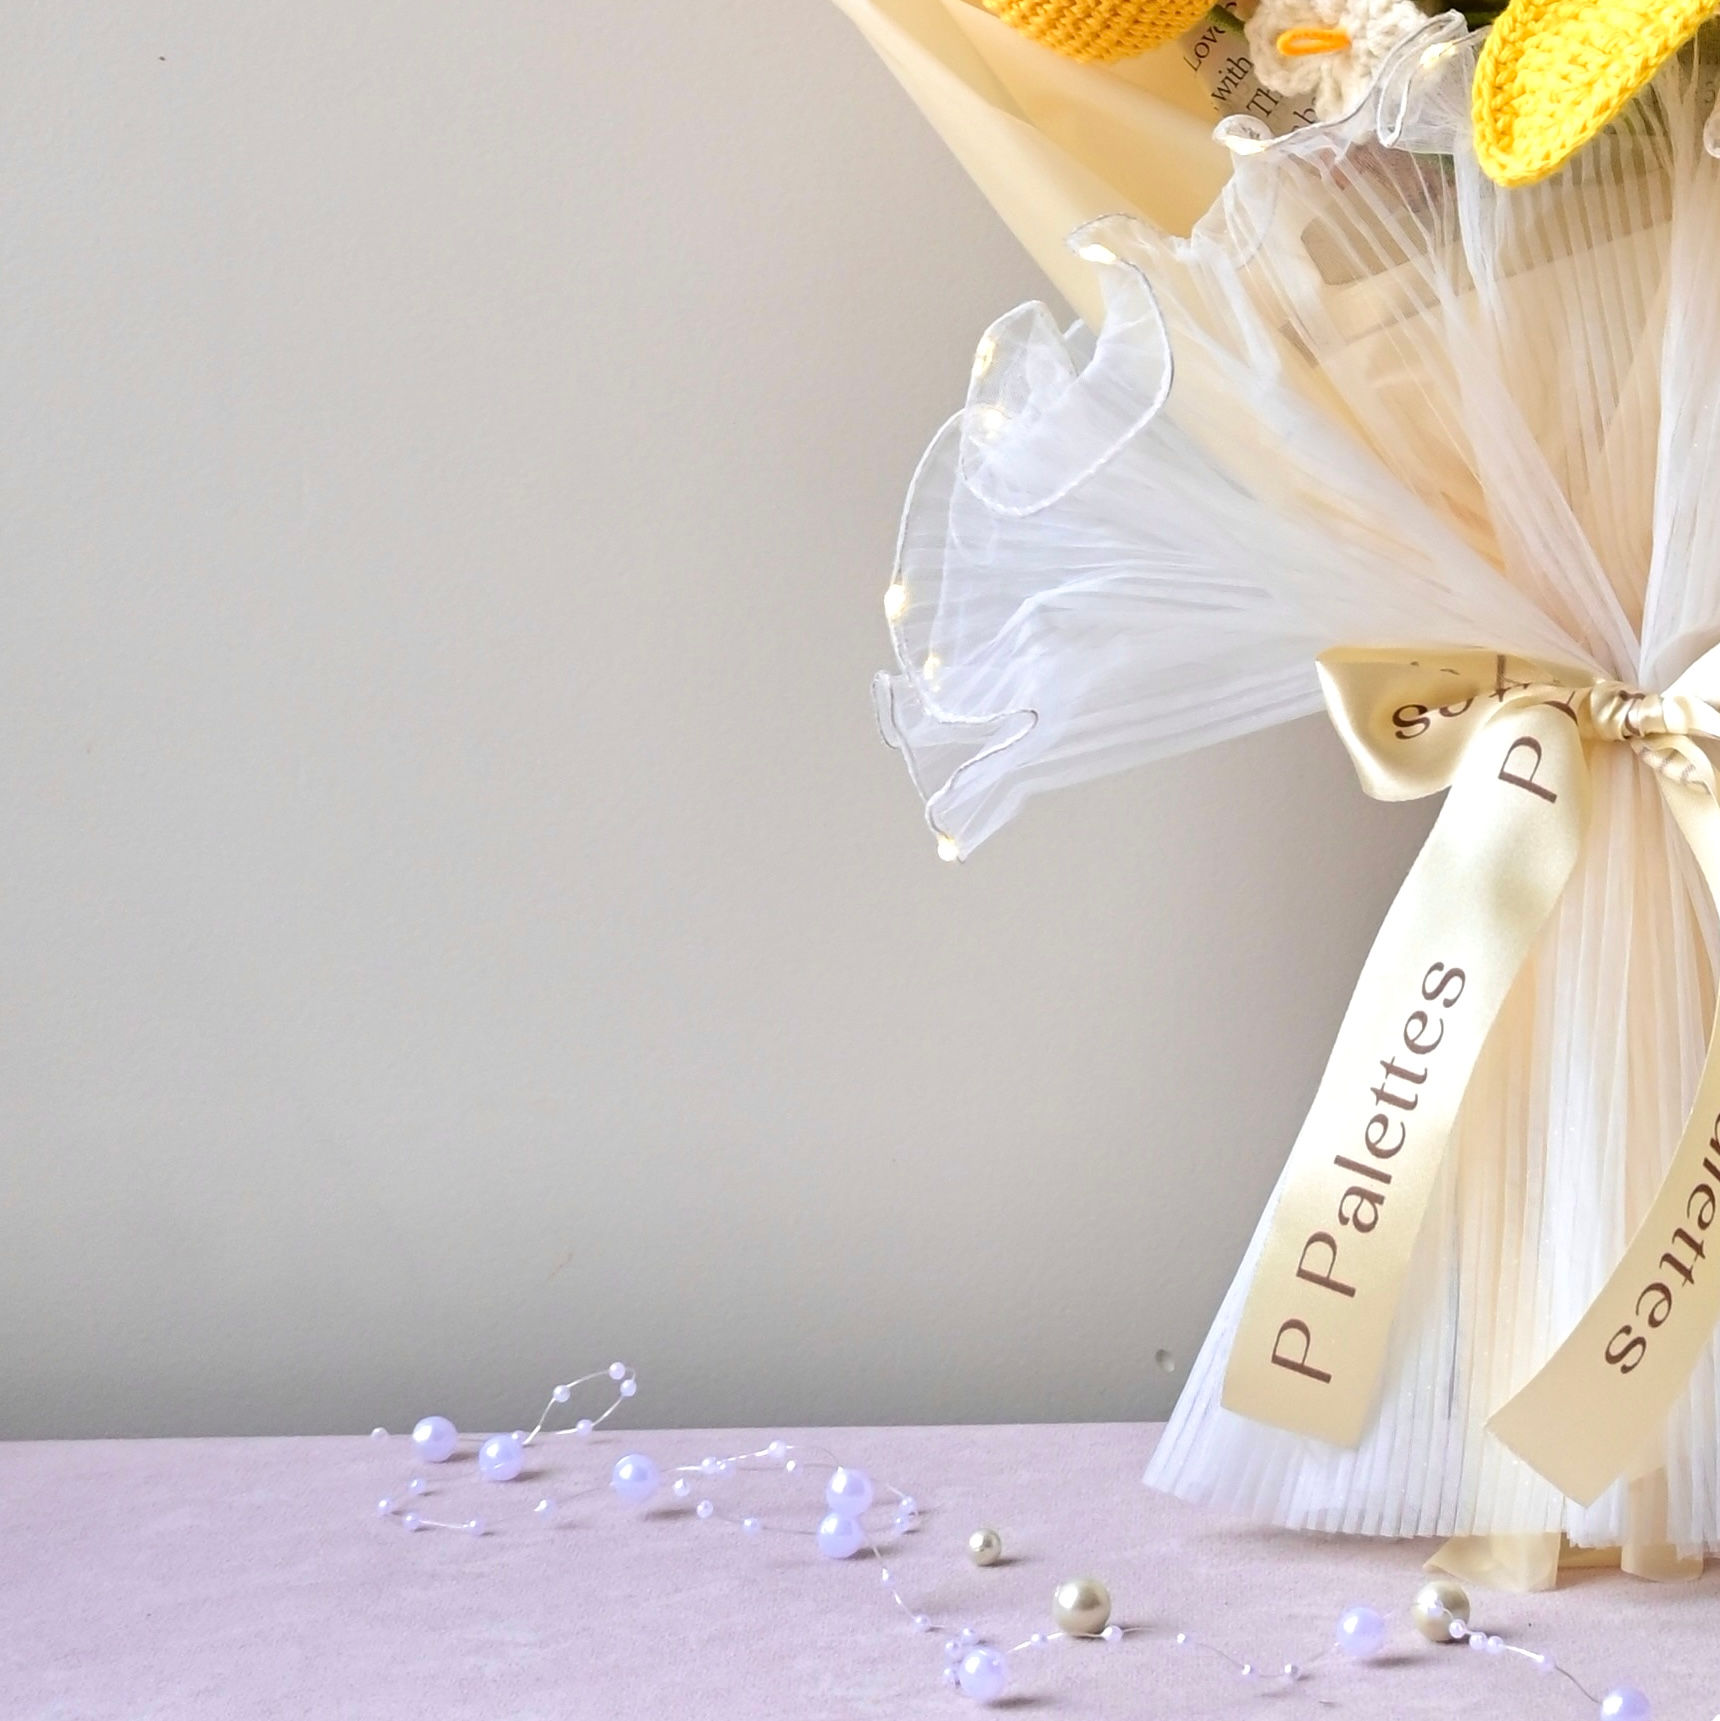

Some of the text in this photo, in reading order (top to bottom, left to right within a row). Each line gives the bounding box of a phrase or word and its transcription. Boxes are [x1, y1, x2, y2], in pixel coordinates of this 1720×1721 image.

[1211, 54, 1254, 104] with
[1271, 960, 1467, 1385] P Palettes
